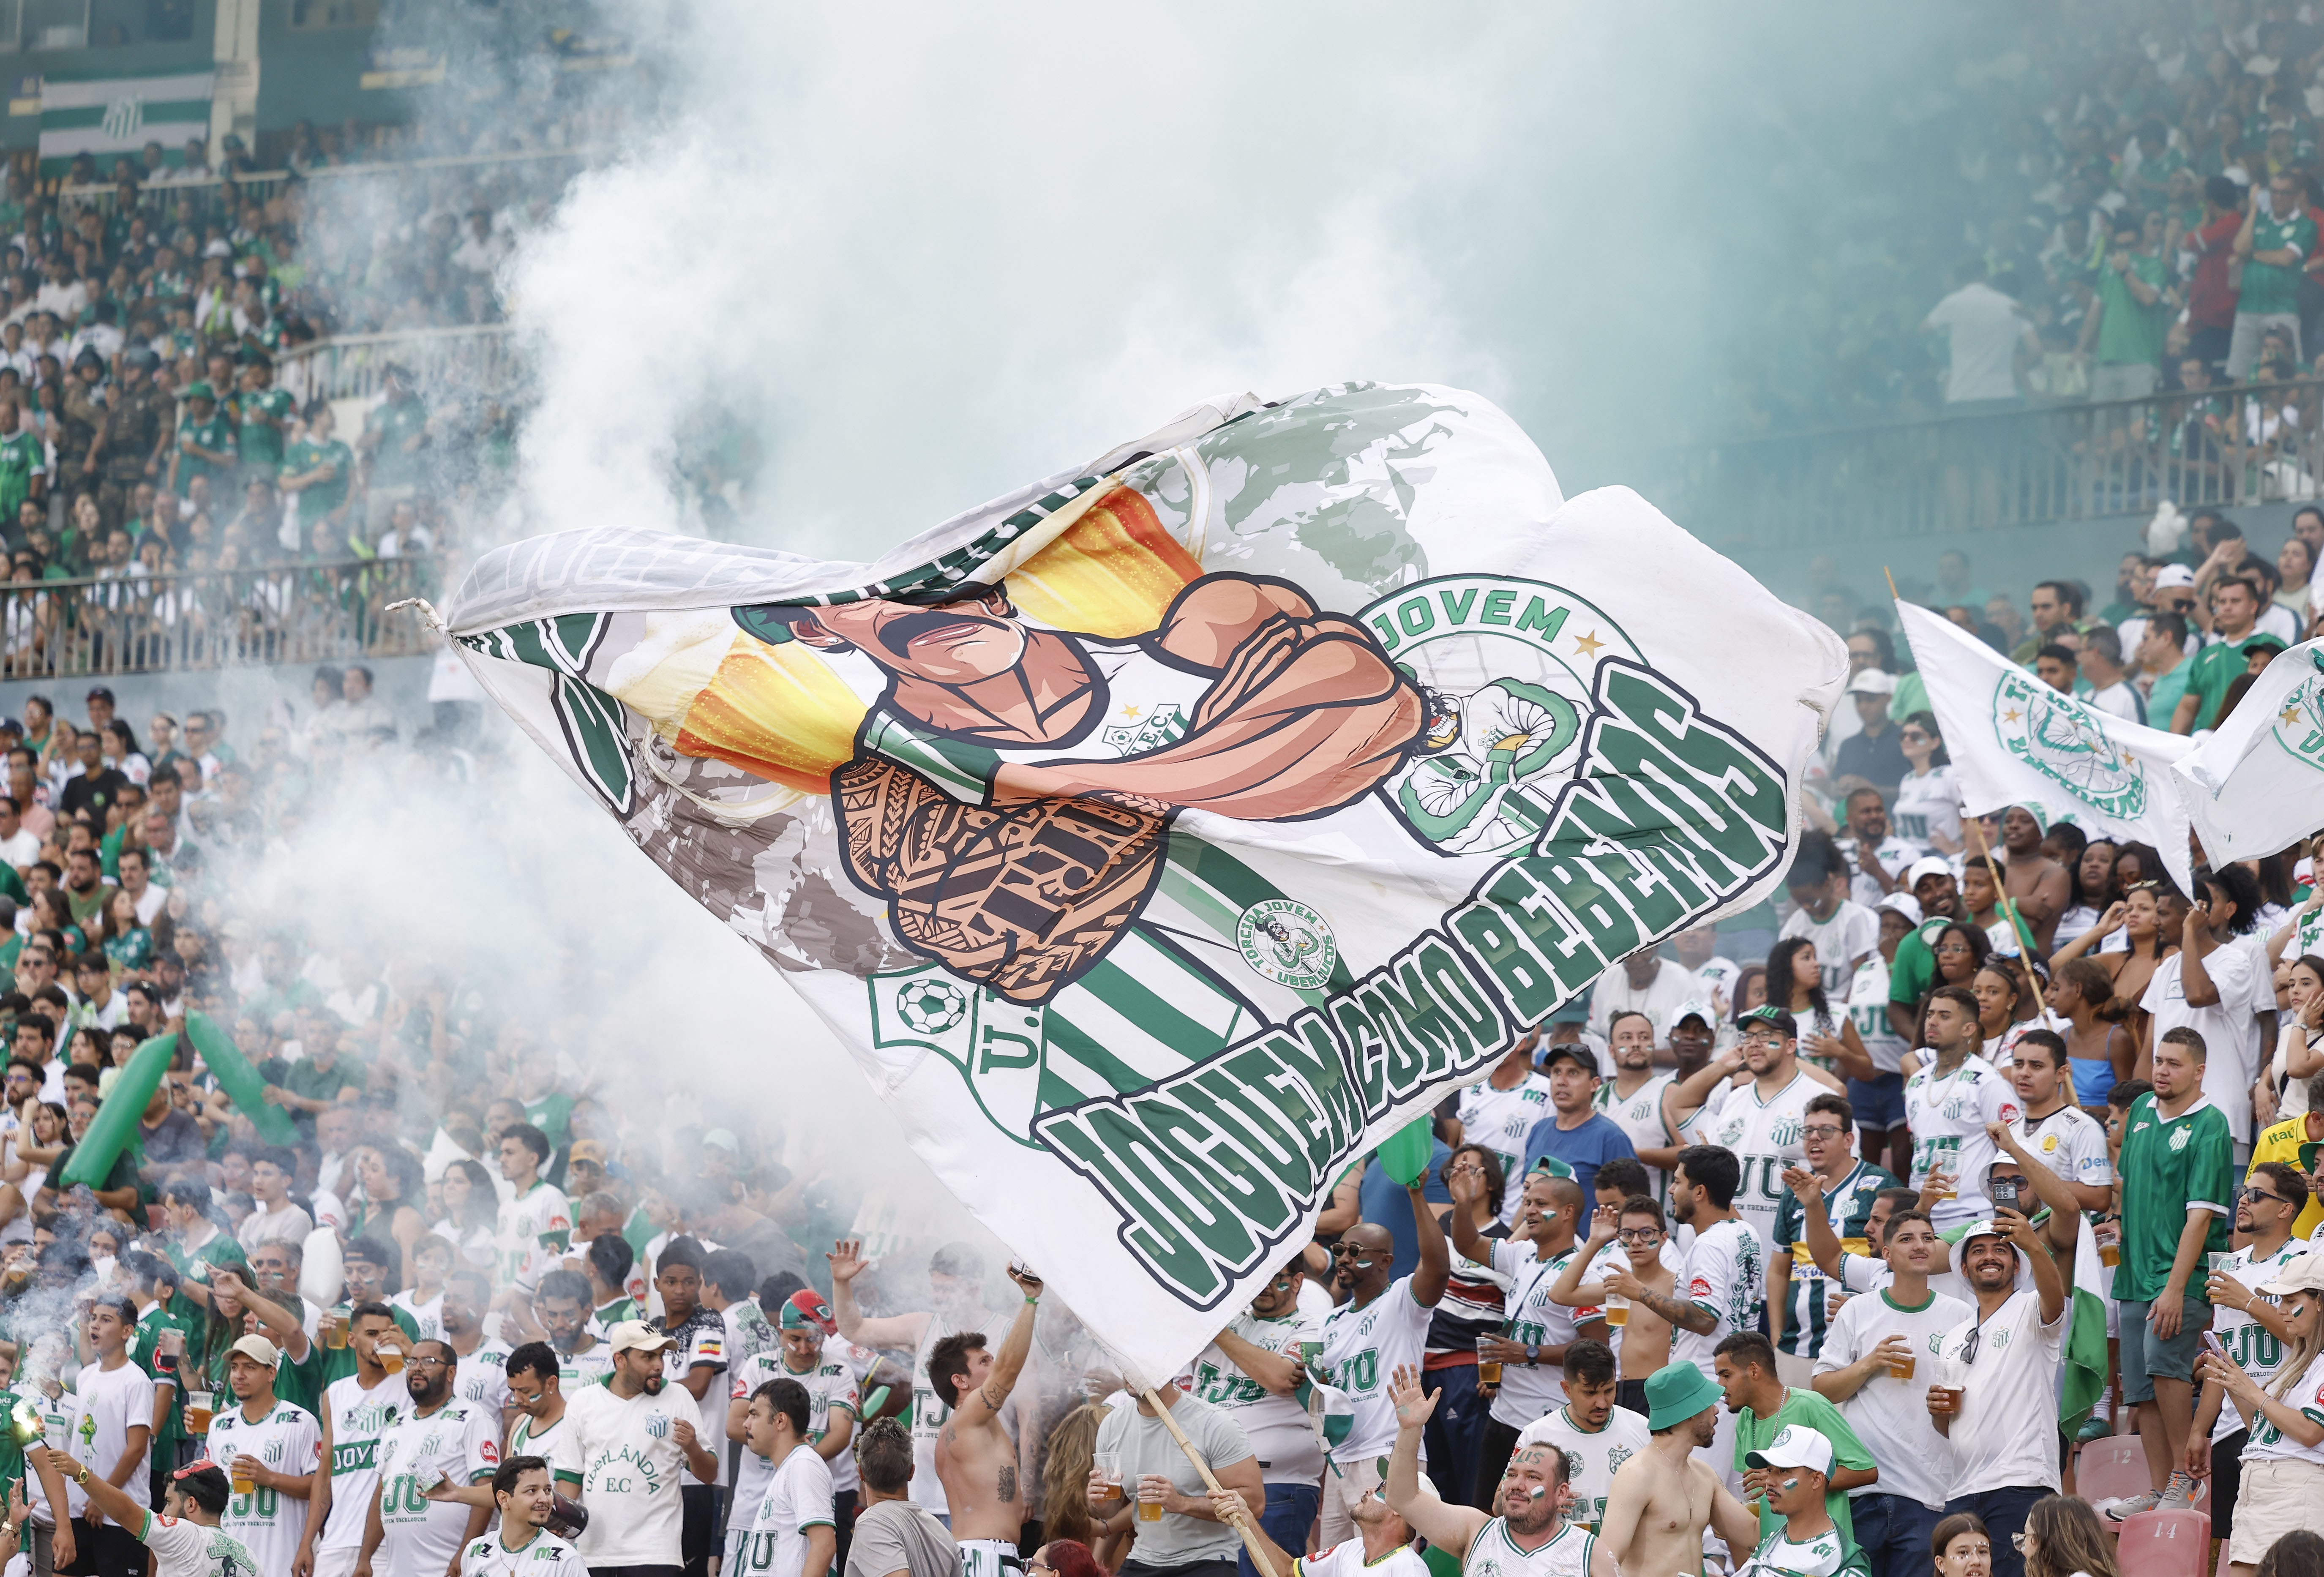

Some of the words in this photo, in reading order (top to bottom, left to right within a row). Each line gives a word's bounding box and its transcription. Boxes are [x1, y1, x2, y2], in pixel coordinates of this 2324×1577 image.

[1372, 589, 1570, 652] JOVEM
[1264, 901, 1318, 924] JOVEM
[1240, 908, 1264, 969] TORCIDA
[1277, 935, 1335, 987] UBERLOUCOS
[1037, 1016, 1361, 1304] JOGUEM
[1339, 940, 1501, 1111] COMO
[1448, 663, 1785, 1032] BEBEMOS
[1733, 1153, 1798, 1201] JU
[913, 1387, 950, 1429] TJ
[1569, 1468, 1582, 1478] LOUCOS
[2112, 1449, 2132, 1464] 12
[383, 1473, 431, 1516] JU
[2154, 1522, 2177, 1539] 14
